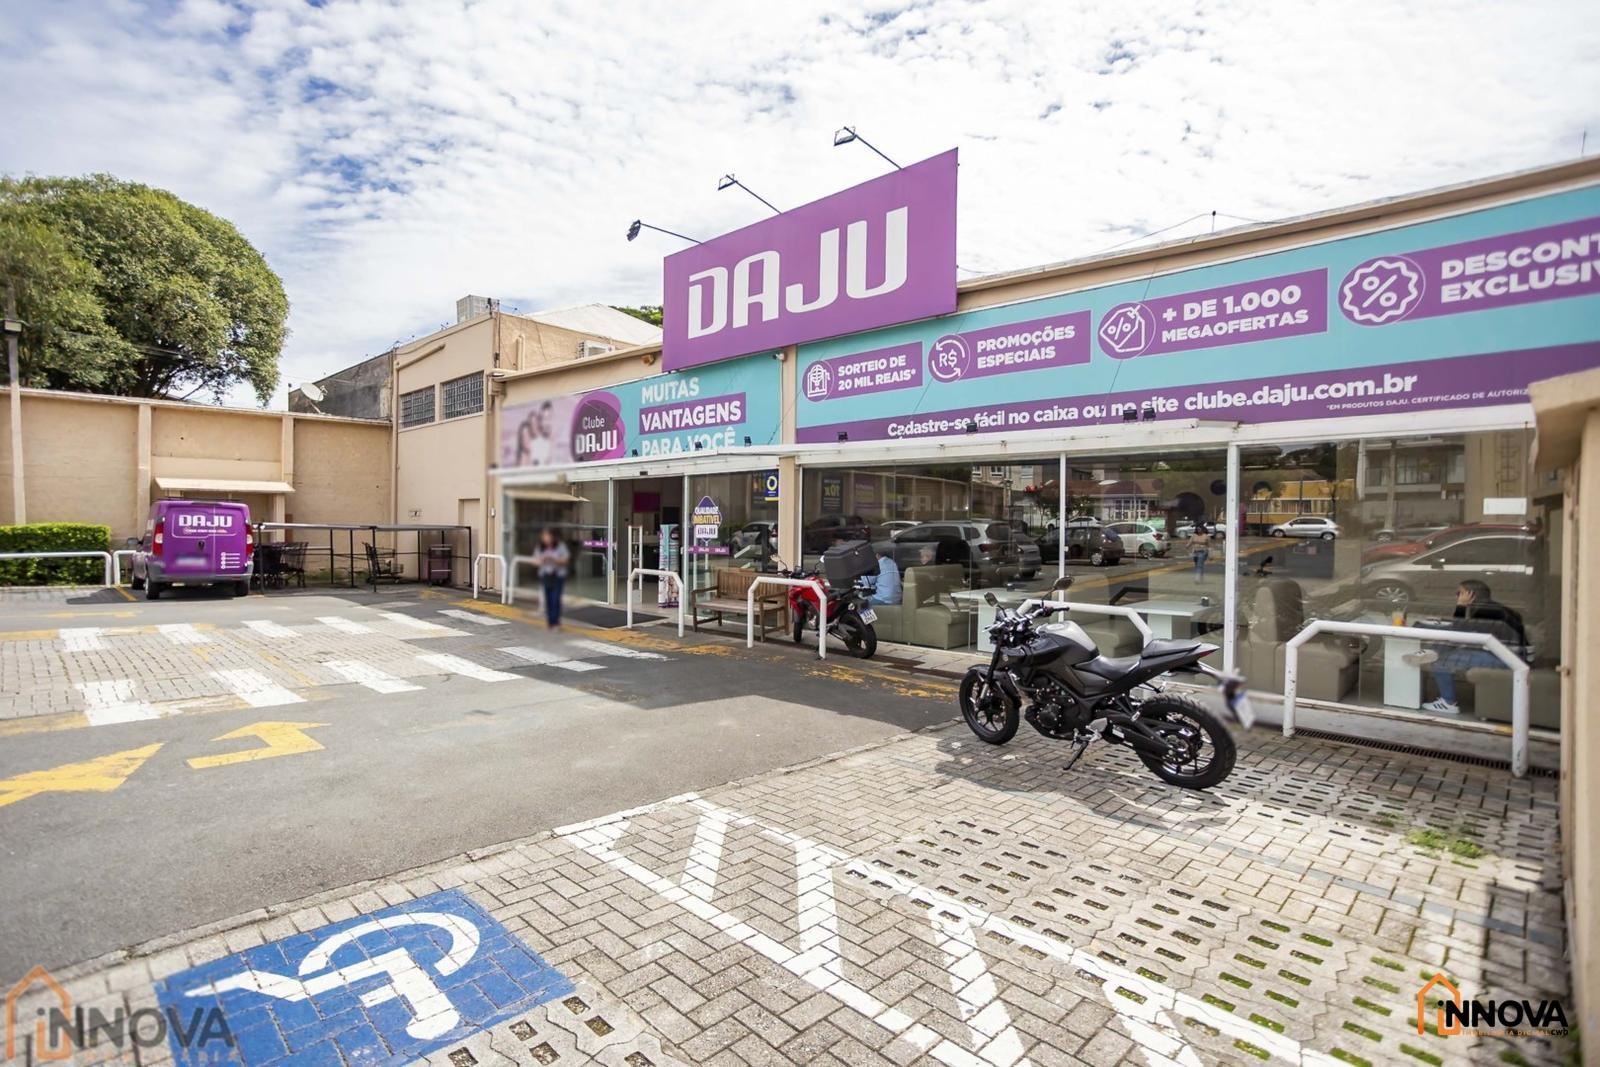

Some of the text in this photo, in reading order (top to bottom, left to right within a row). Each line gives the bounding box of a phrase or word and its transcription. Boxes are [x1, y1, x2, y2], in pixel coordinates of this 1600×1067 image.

[687, 205, 909, 340] DAJU
[1440, 259, 1600, 304] EXCLUSI
[1183, 299, 1217, 321] DE
[1222, 284, 1302, 315] 1.000
[976, 325, 1076, 353] PROMOÇÕES
[1161, 309, 1309, 344] MEGAOFERTAS
[837, 354, 907, 377] SORTEIO DE
[976, 346, 1056, 370] ESPECIAIS
[640, 376, 700, 405] MUITAS
[837, 378, 853, 392] 20
[854, 376, 874, 389] MIL
[887, 416, 971, 437] Cadastre-se
[973, 410, 1005, 428] fácil
[1008, 409, 1030, 425] no
[1033, 404, 1079, 423] caixa
[1082, 404, 1107, 420] ou
[1140, 395, 1179, 414] site
[1184, 373, 1418, 411] clube.daju.com.br
[1341, 400, 1384, 410] PRODUTOS
[1411, 392, 1470, 404] CERTIFICADO
[1472, 391, 1486, 399] DE
[582, 416, 605, 430] Clube
[641, 400, 742, 432] VANTAGENS
[576, 429, 618, 455] DAJU
[641, 426, 736, 457] PARA VOCÊ
[178, 514, 233, 528] DAJU
